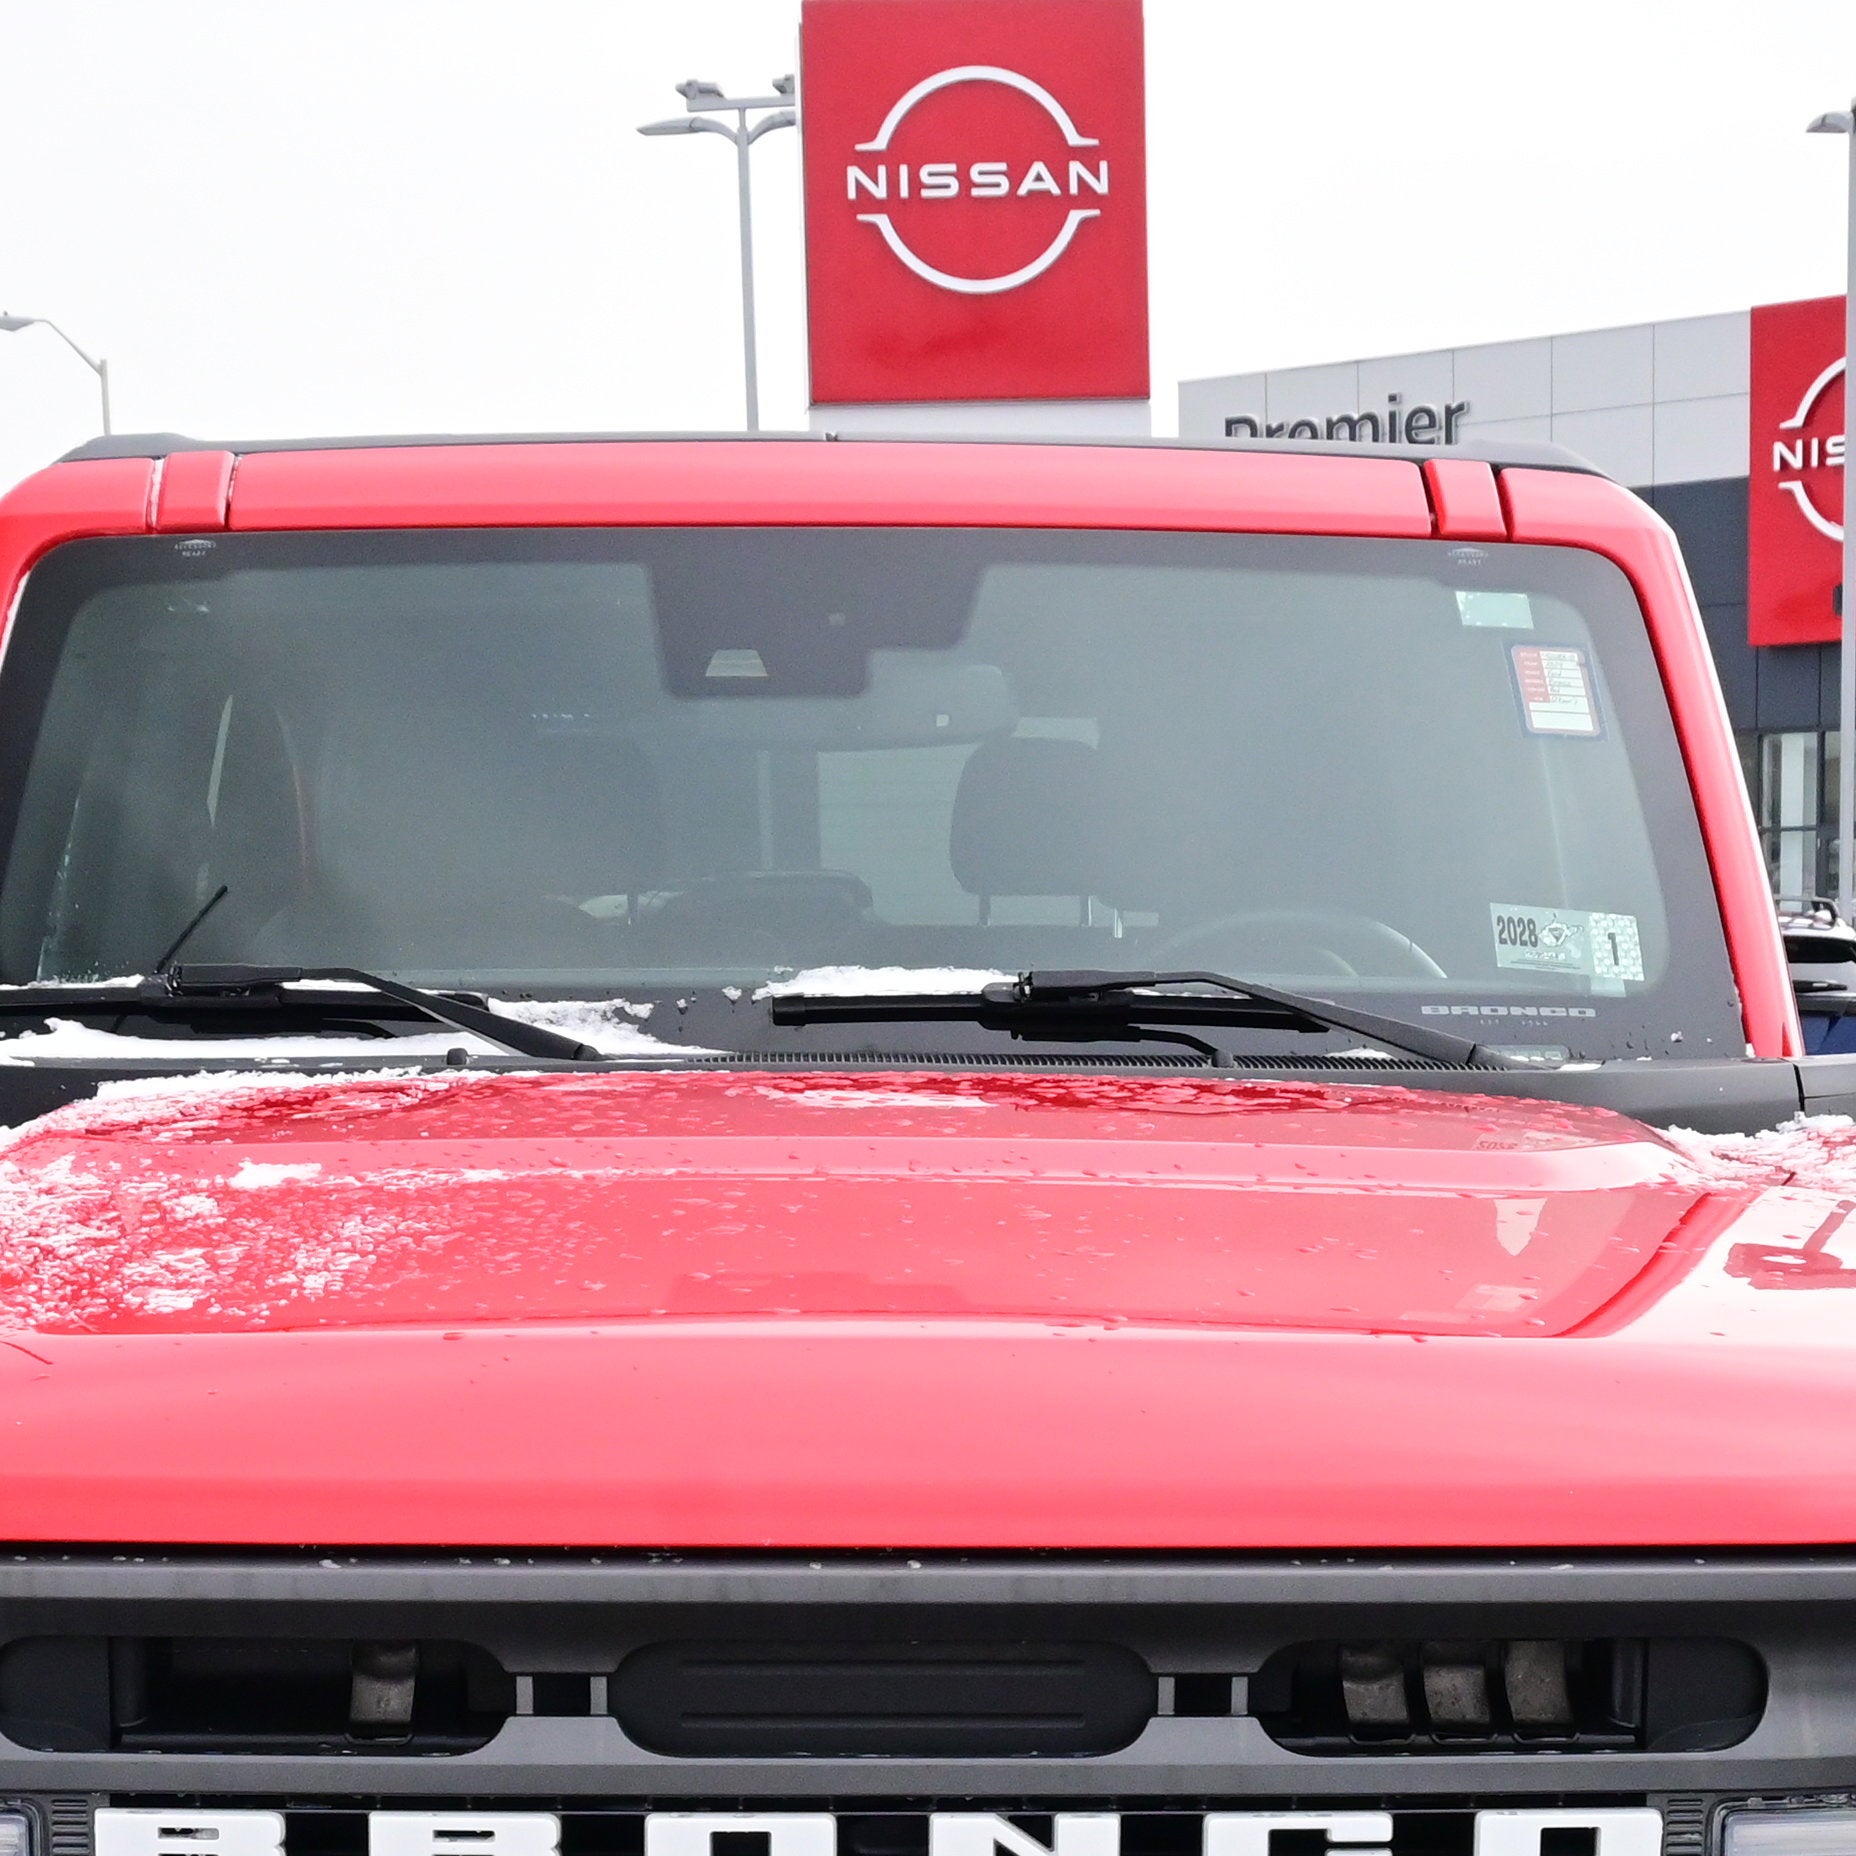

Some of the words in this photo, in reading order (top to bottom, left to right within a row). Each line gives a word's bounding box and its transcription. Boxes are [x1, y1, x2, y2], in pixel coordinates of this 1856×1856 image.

[846, 158, 1110, 202] NISSAN
[1497, 914, 1539, 948] 2028
[1607, 931, 1620, 967] 1
[1421, 1005, 1597, 1018] BRONCO
